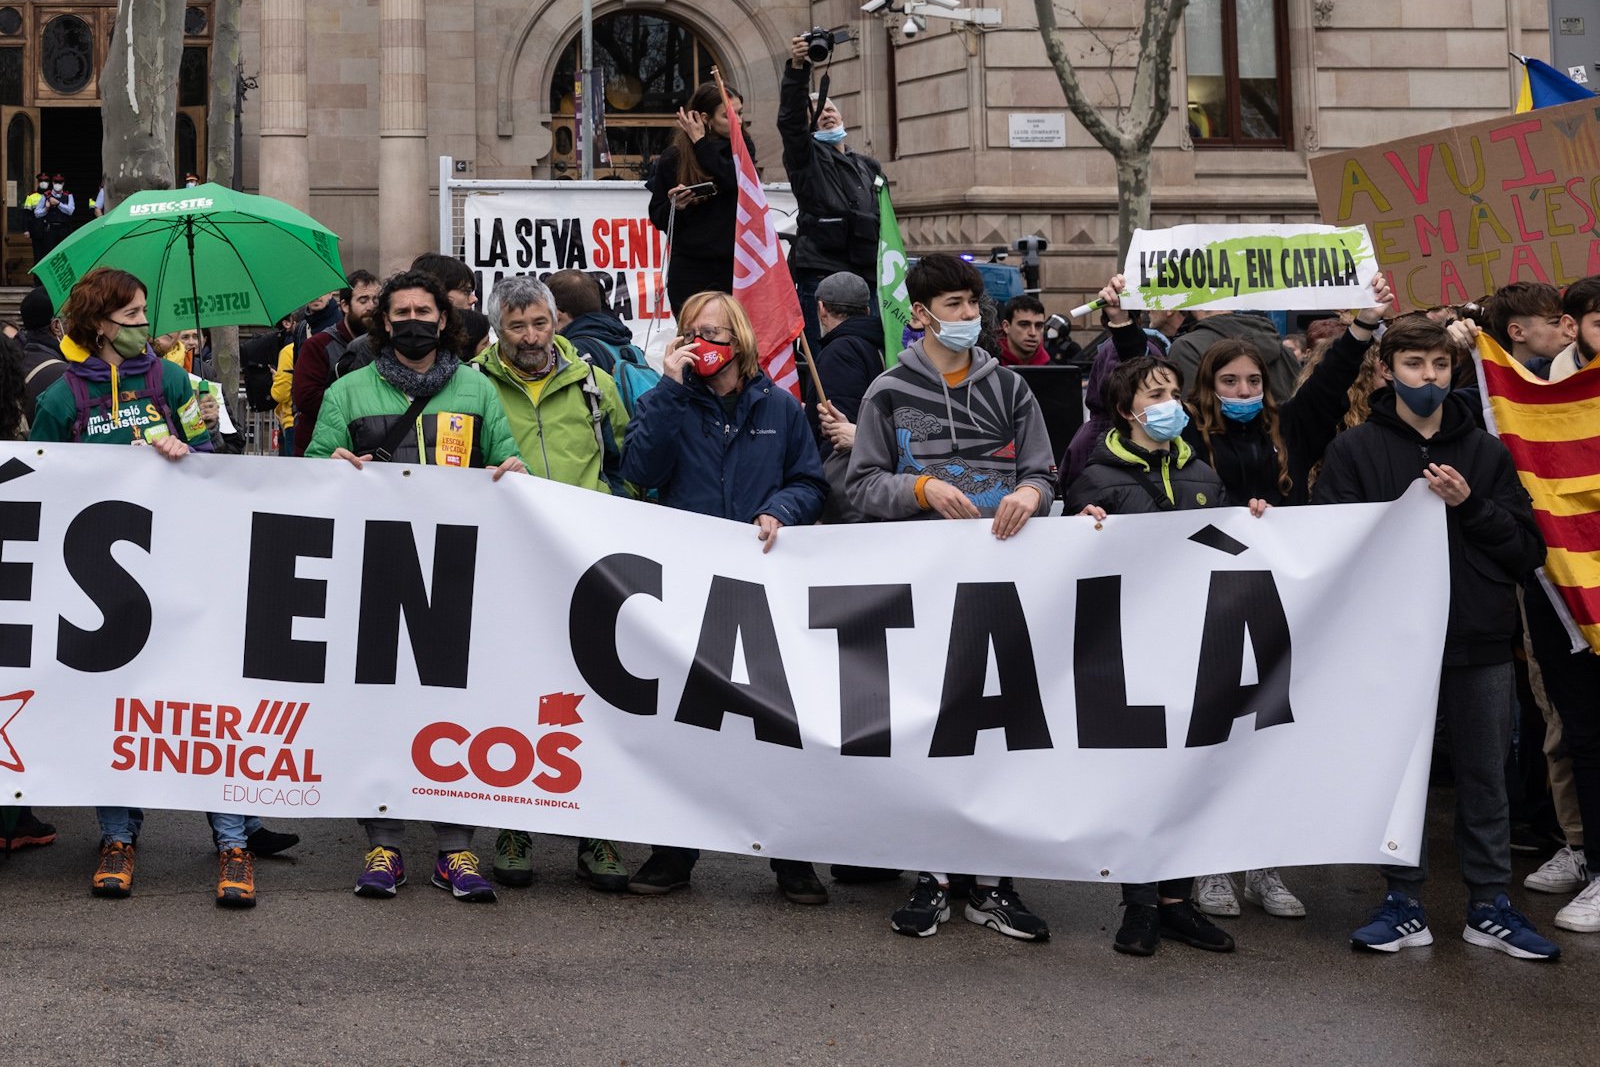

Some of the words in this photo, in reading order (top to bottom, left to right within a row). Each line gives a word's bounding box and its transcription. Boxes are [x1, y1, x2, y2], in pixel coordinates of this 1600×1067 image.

[1337, 119, 1557, 222] AVUI
[474, 218, 510, 267] LA
[515, 217, 588, 270] SEVA
[1372, 194, 1513, 265] EMÀ
[1139, 248, 1241, 297] L'ESCOLA,
[1245, 248, 1275, 288] EN
[1280, 239, 1360, 288] CATALÀ
[242, 511, 479, 689] EN
[568, 523, 1295, 758] CATALÀ
[110, 734, 322, 783] SINDICAL
[411, 721, 583, 794] COS
[223, 785, 321, 806] EDUCACIÓ
[412, 787, 491, 801] COORDINADORA
[493, 794, 533, 806] OBRERA
[534, 798, 580, 810] SINDICAL
